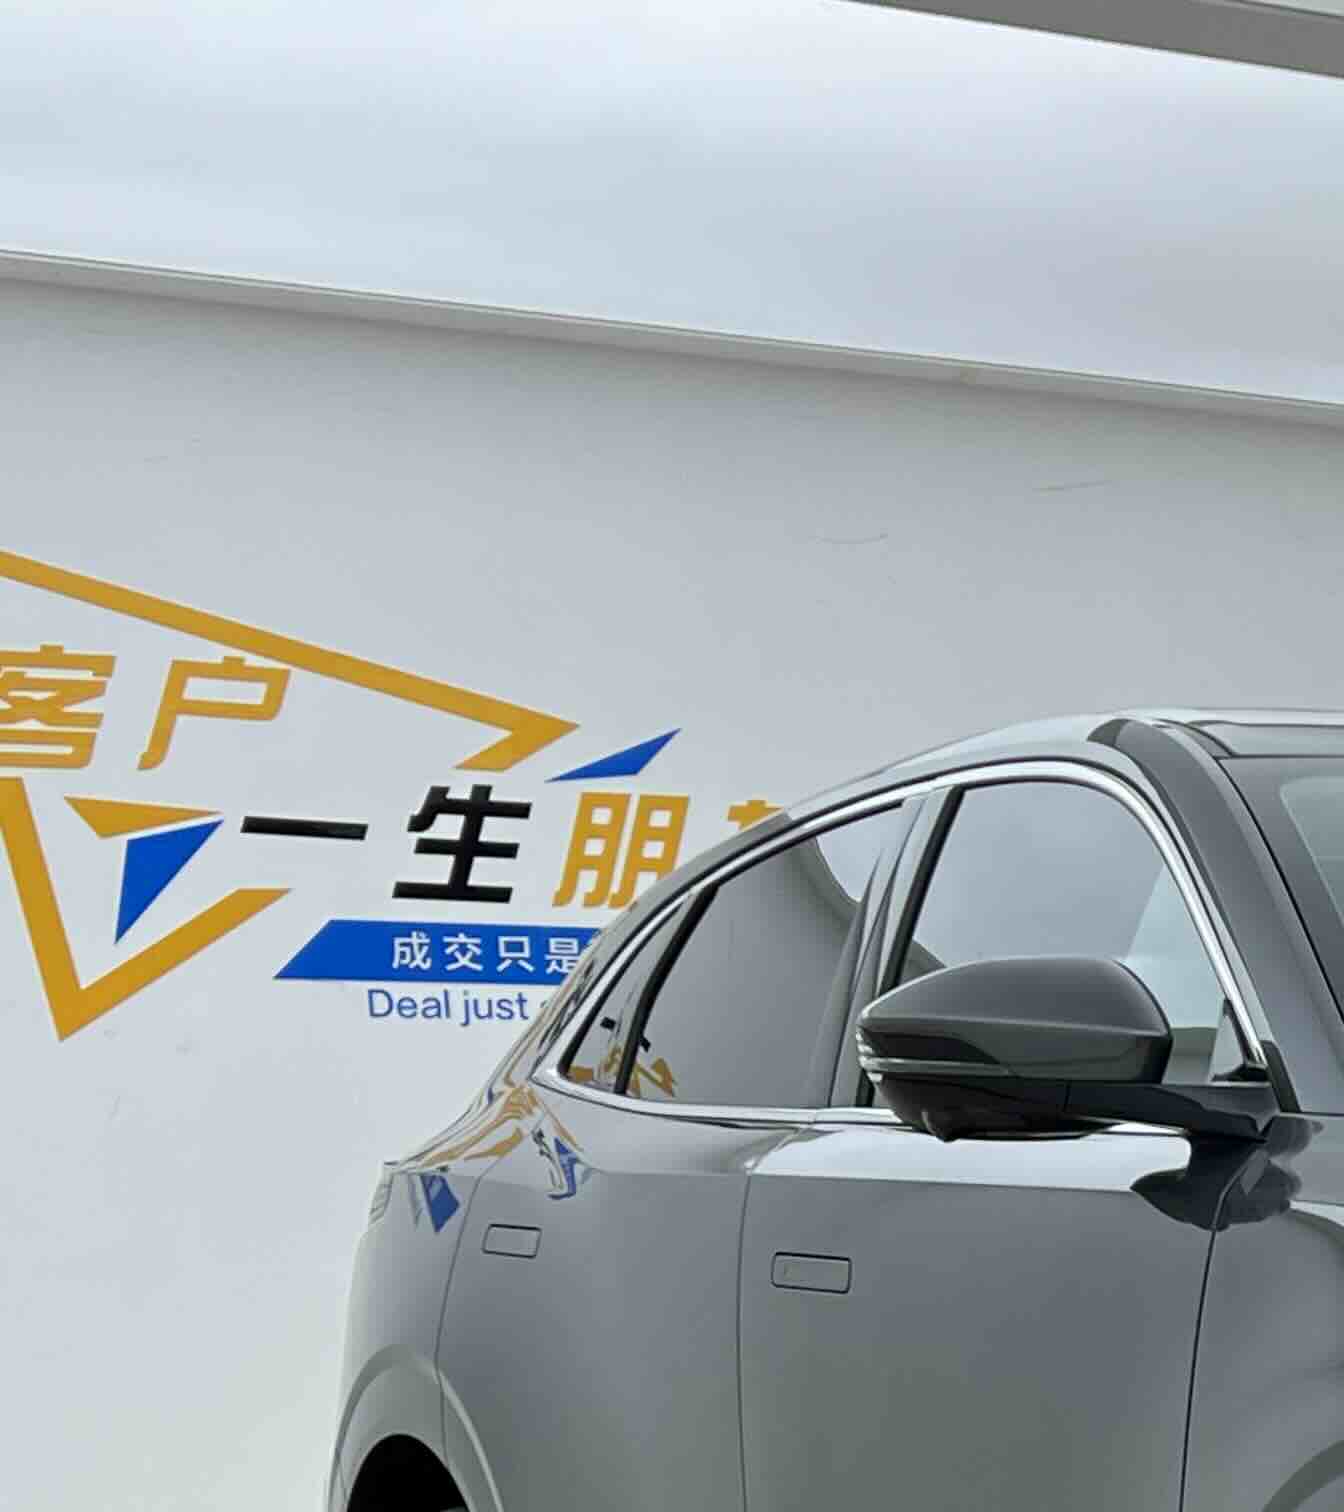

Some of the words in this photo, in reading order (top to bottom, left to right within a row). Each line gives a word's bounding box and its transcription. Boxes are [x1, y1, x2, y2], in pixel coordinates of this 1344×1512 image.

[0, 644, 290, 771] 客户
[367, 988, 451, 1019] Deal
[461, 990, 530, 1027] just
